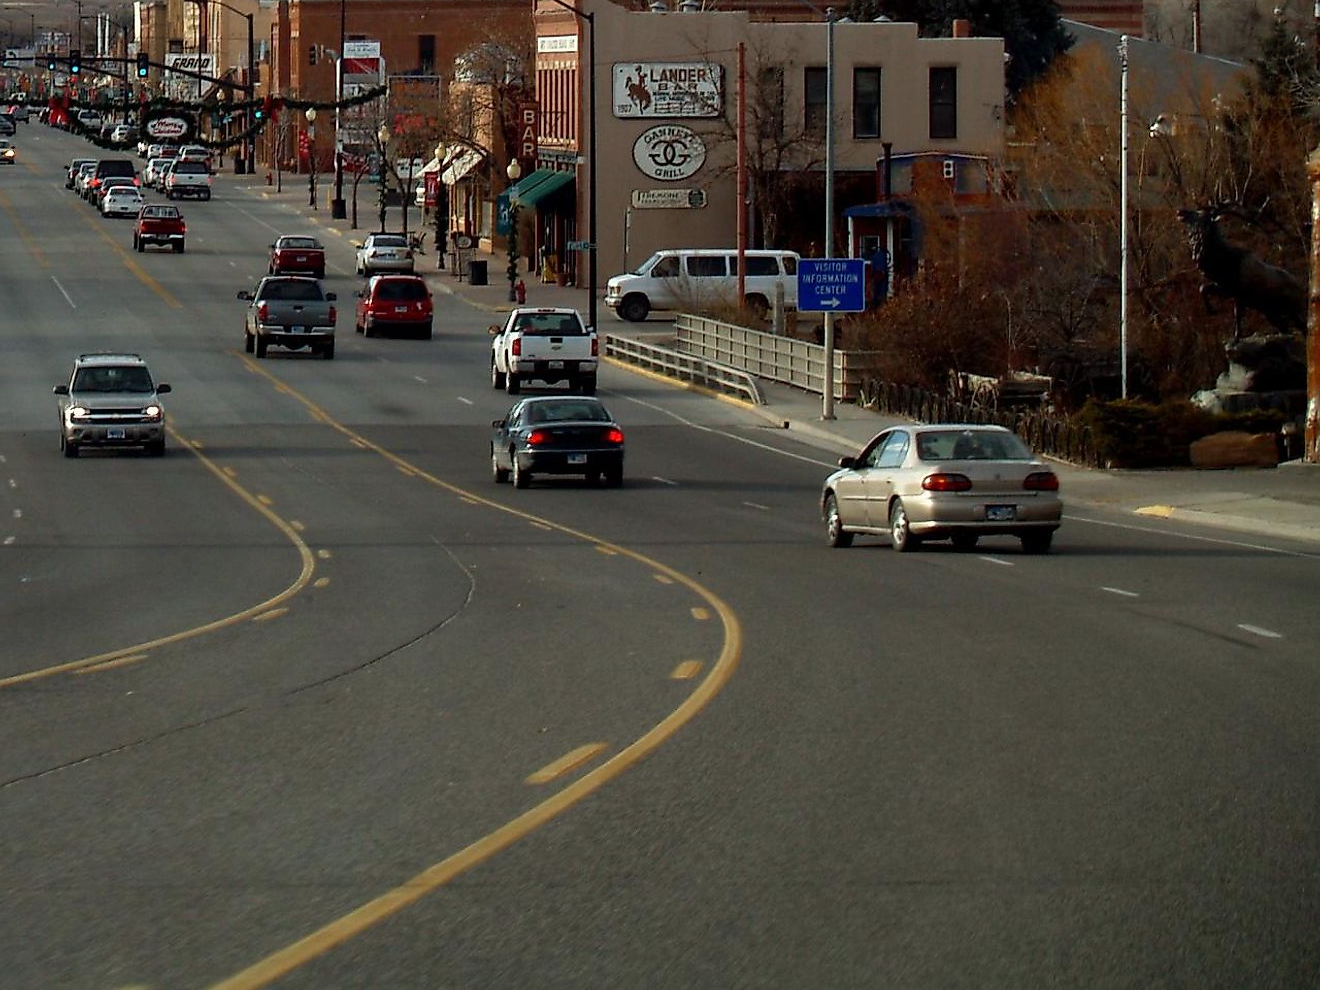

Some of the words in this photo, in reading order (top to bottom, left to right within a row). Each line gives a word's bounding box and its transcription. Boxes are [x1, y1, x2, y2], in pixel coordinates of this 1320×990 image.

[650, 68, 707, 83] LANDER
[522, 109, 535, 156] BAR
[654, 168, 685, 178] GRILL
[814, 262, 848, 272] VISITOR
[802, 273, 859, 284] INFORMATION
[814, 285, 847, 295] CENTER
